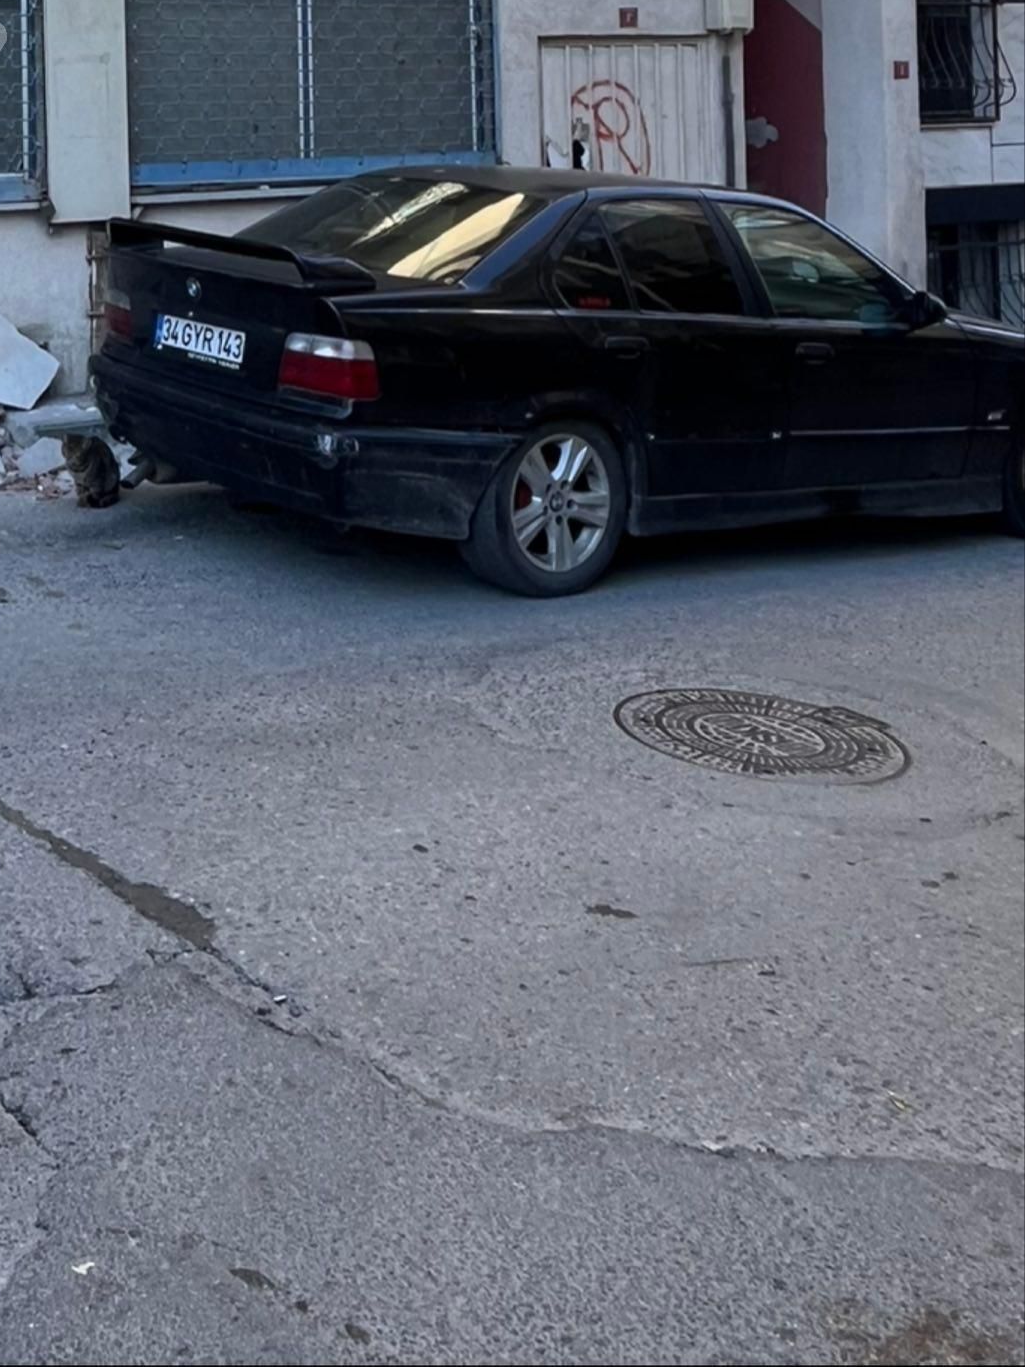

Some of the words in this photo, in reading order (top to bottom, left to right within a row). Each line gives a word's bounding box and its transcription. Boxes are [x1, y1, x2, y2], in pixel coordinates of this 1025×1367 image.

[163, 318, 179, 344] 34
[181, 323, 214, 353] GYR
[217, 330, 243, 359] 143
